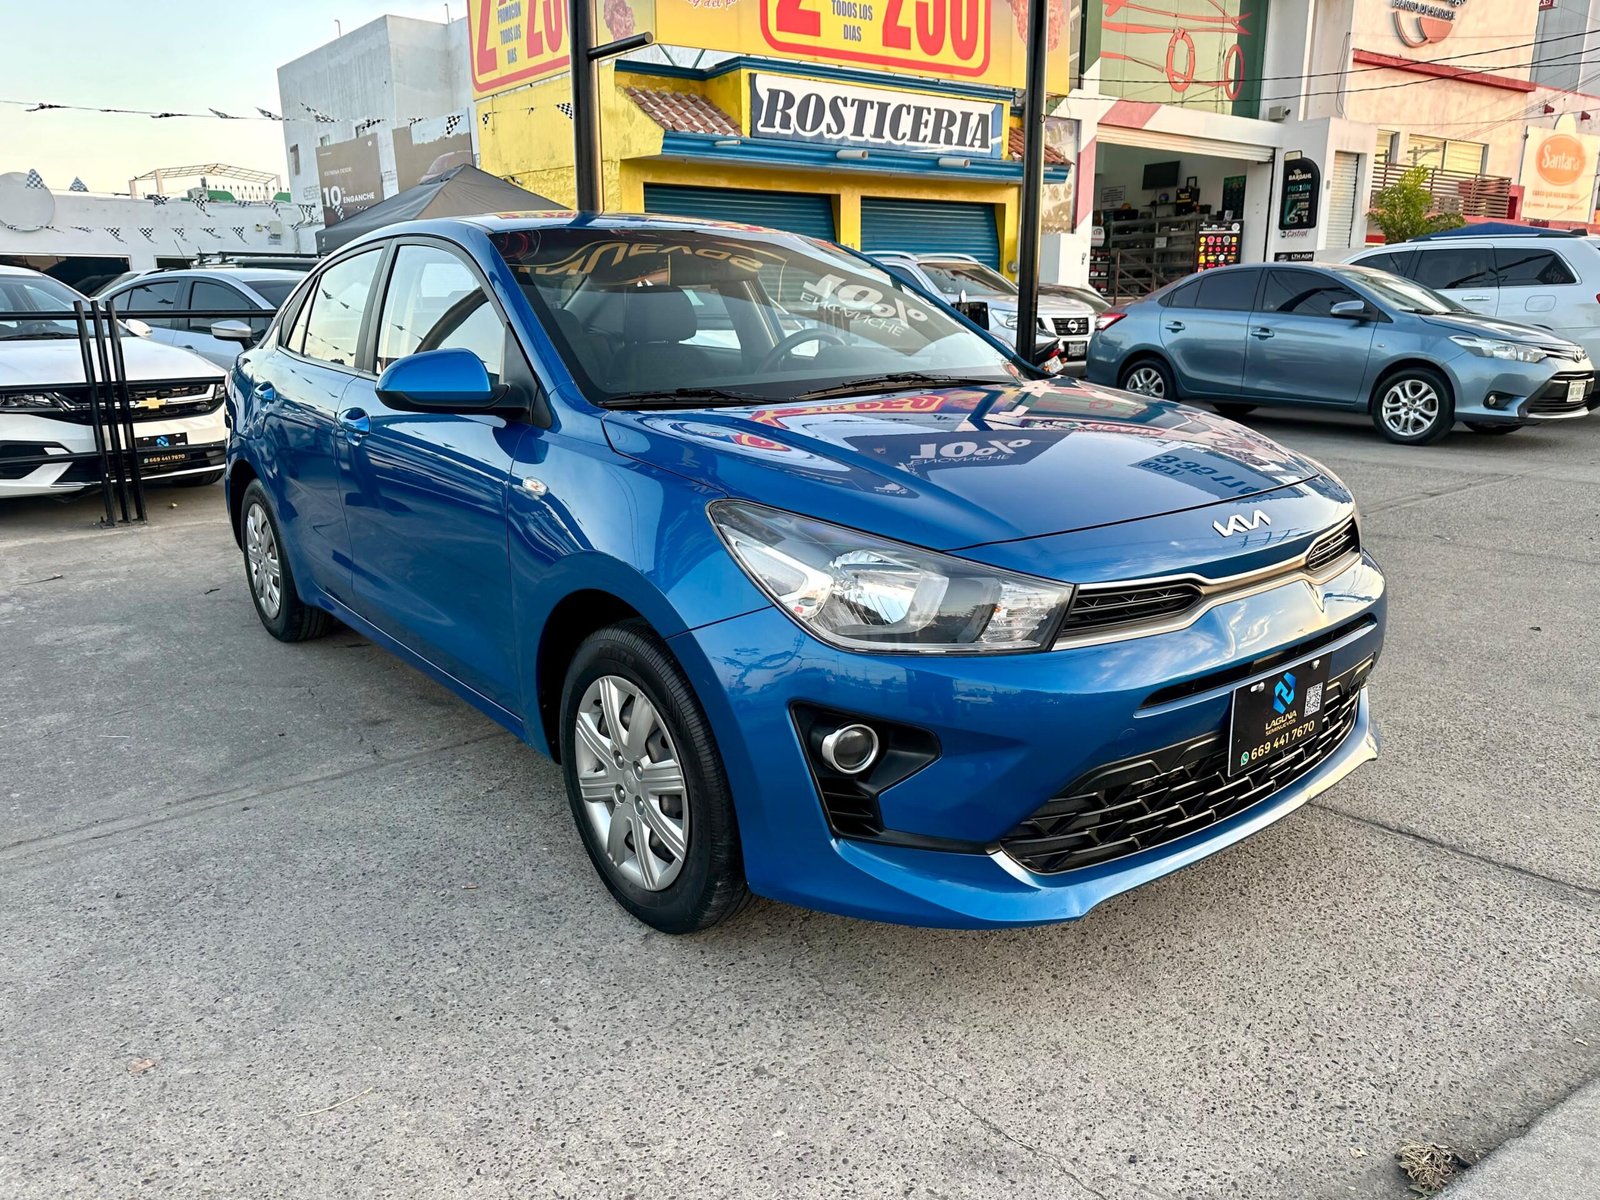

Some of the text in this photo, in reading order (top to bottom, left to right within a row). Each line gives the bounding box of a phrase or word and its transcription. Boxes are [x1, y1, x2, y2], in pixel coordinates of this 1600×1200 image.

[831, 0, 873, 21] TODOS LOS
[500, 24, 521, 45] TODOS LOS
[843, 24, 862, 42] DIAS
[507, 48, 518, 64] DIAS
[760, 88, 990, 150] ROSTICERIA
[1542, 144, 1580, 170] Santara
[343, 192, 375, 204] ENGANCHE
[1287, 230, 1309, 238] Castrol
[1265, 710, 1298, 731] LAGUNA
[1265, 719, 1297, 736] SEMINUEVOS
[1251, 720, 1315, 760] 669 441 7670
